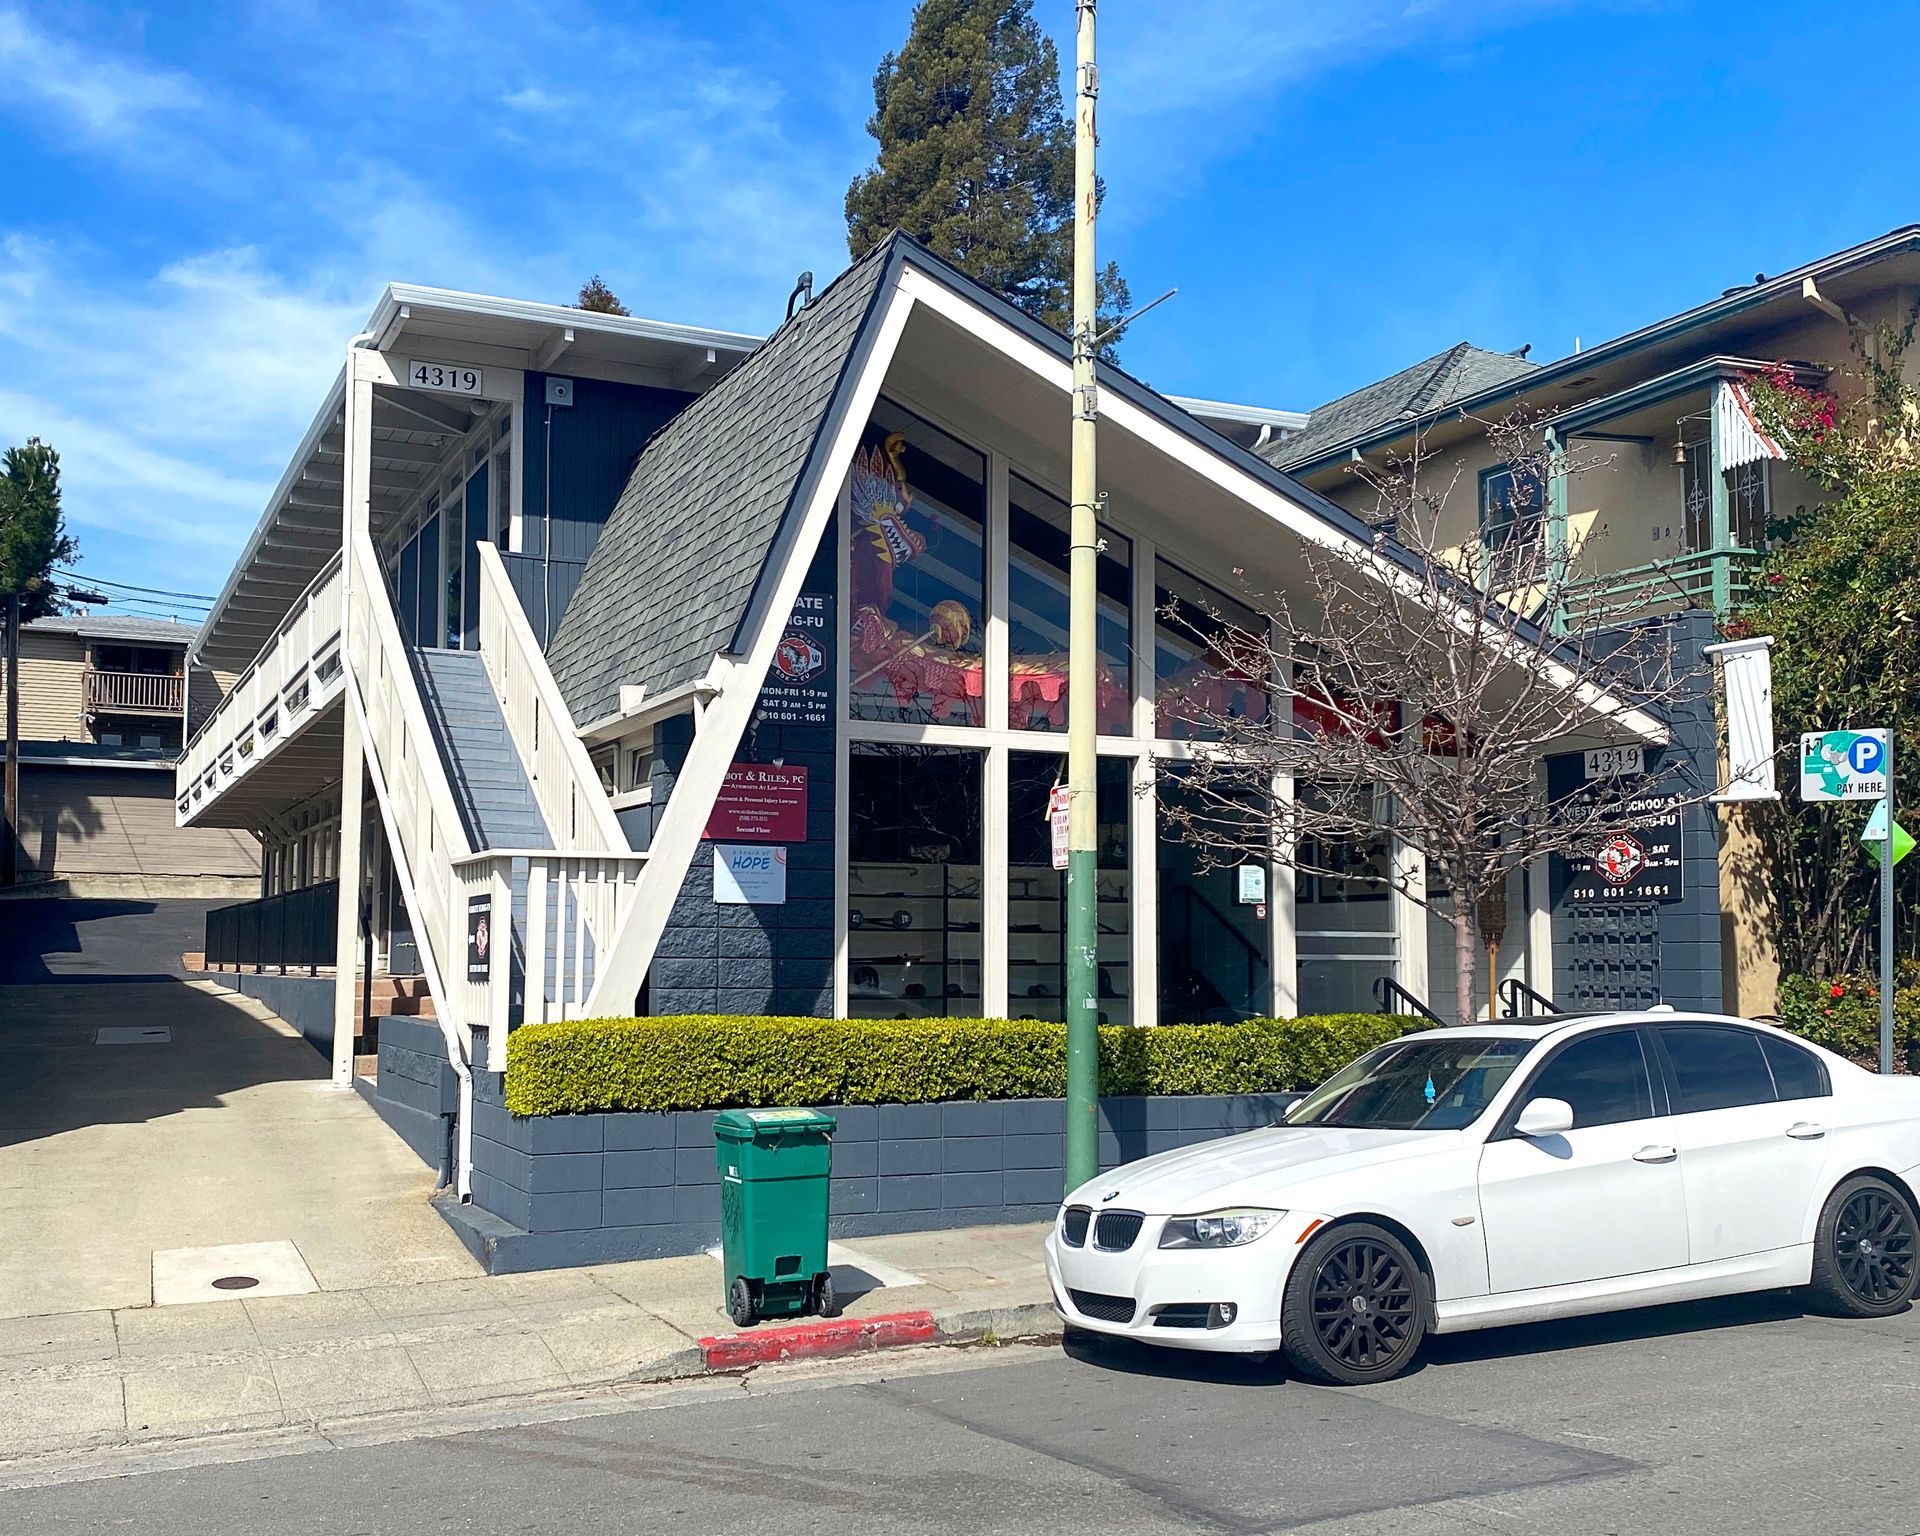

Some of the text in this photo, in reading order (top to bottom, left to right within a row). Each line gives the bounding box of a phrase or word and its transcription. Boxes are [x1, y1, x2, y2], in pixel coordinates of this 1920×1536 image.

[415, 365, 477, 390] 4319
[795, 597, 823, 609] ATE
[761, 687, 799, 696] MON-FRI
[801, 689, 815, 697] 1-9
[762, 699, 780, 707] SAT
[1589, 748, 1639, 773] 4319
[746, 771, 755, 781] &
[1836, 782, 1883, 793] PAY HERE
[1652, 844, 1670, 855] SAT
[732, 856, 771, 870] HOPE
[1571, 863, 1582, 871] 1-9
[1573, 888, 1595, 899] 510
[1603, 887, 1625, 897] 601
[1637, 885, 1669, 897] 1661
